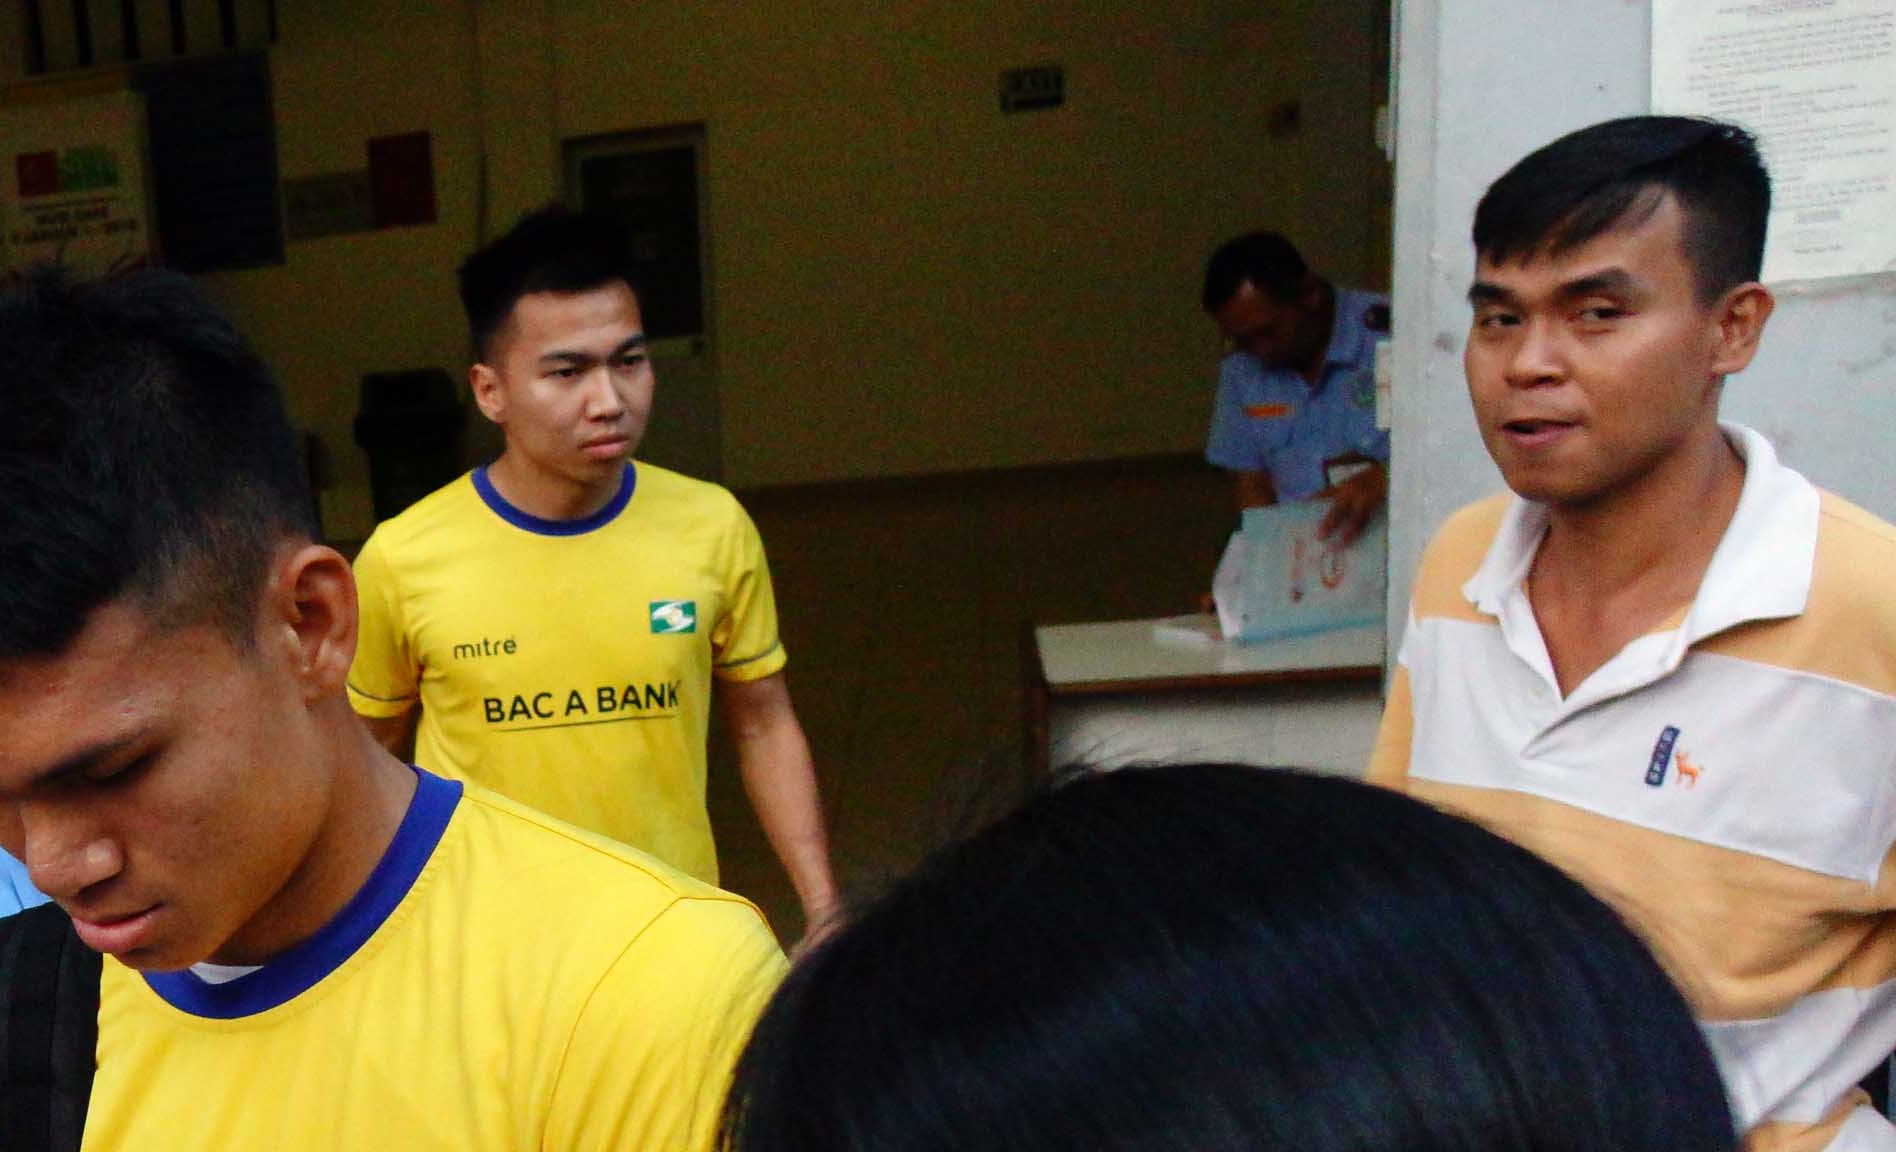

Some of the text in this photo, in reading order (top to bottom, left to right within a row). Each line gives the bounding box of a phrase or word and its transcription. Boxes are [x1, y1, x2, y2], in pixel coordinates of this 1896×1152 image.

[454, 637, 517, 660] mitre
[483, 680, 683, 723] BAC A BANK
